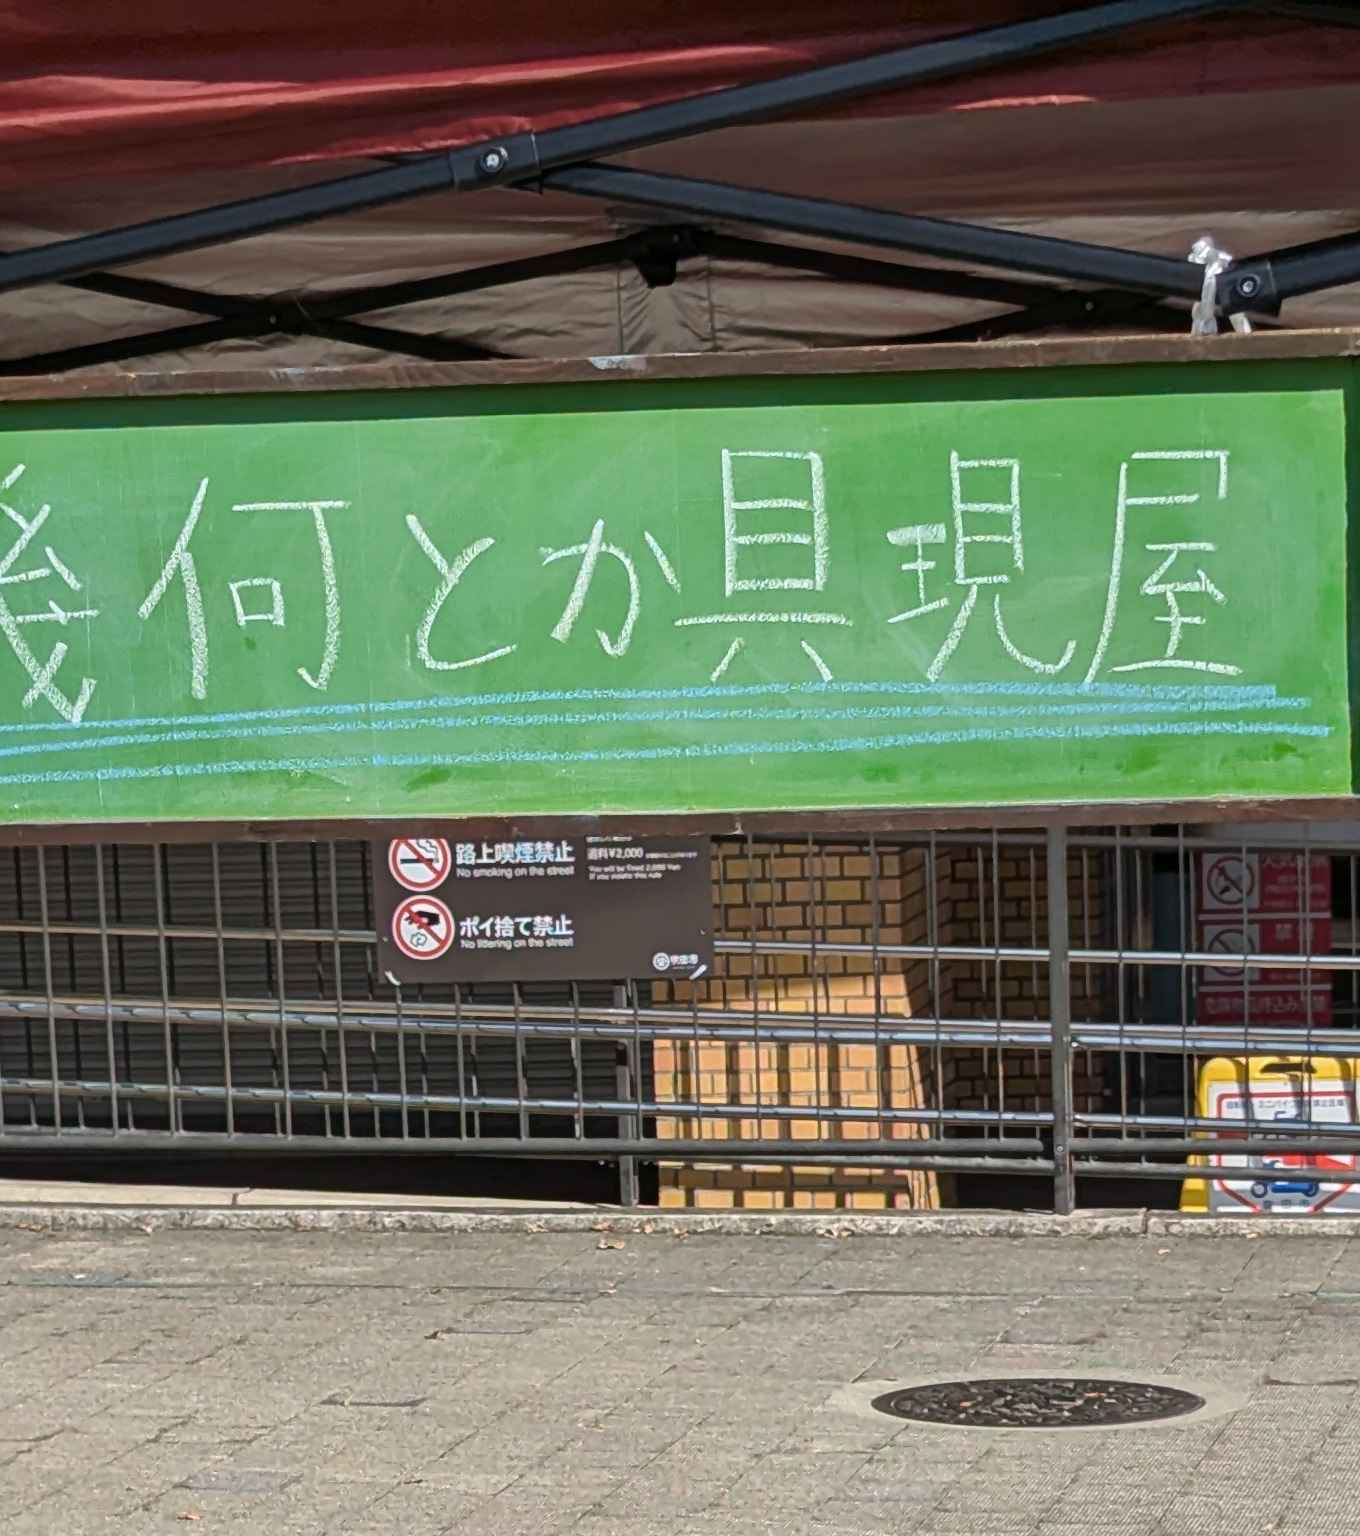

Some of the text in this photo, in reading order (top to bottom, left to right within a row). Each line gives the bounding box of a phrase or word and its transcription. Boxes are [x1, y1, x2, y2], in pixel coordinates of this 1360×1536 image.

[455, 840, 576, 865] 路上喫煙禁止
[456, 865, 575, 879] No smoking on the street
[459, 914, 575, 938] ポイ捨て禁止
